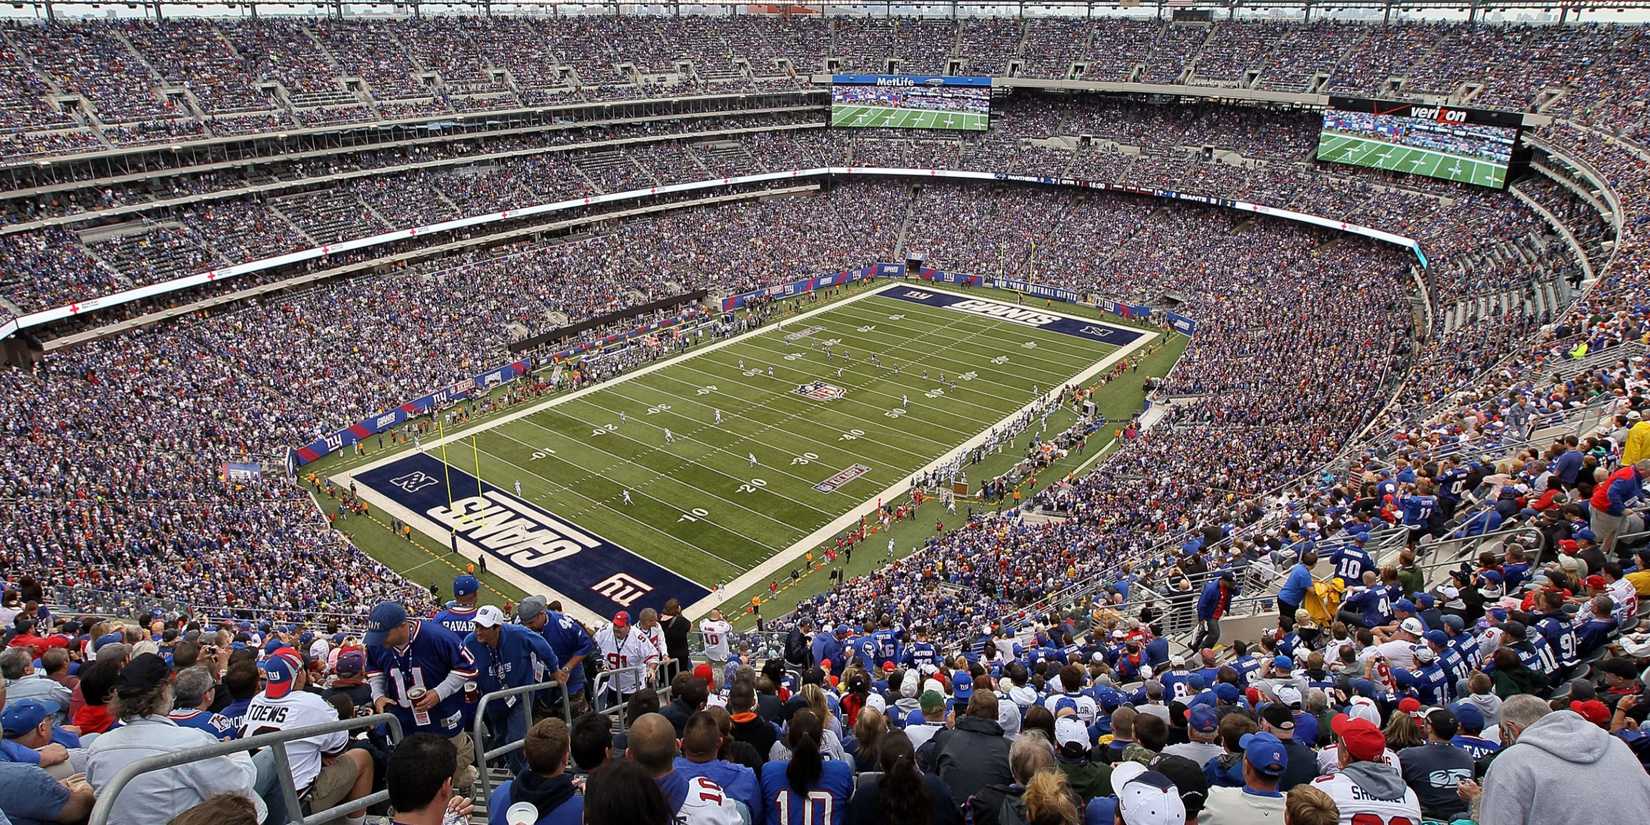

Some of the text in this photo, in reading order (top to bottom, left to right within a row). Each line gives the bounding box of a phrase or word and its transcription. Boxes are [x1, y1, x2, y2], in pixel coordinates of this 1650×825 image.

[877, 77, 915, 87] MetLife
[1411, 106, 1467, 124] verizon
[950, 299, 1064, 326] GIANTS
[794, 452, 819, 465] 30
[741, 478, 767, 493] 20
[683, 507, 709, 523] 10
[426, 495, 583, 568] GIANTS
[1338, 557, 1361, 579] 10
[703, 633, 719, 646] 10
[607, 652, 627, 670] 91
[248, 704, 289, 723] TOEWS
[776, 790, 833, 825] 10
